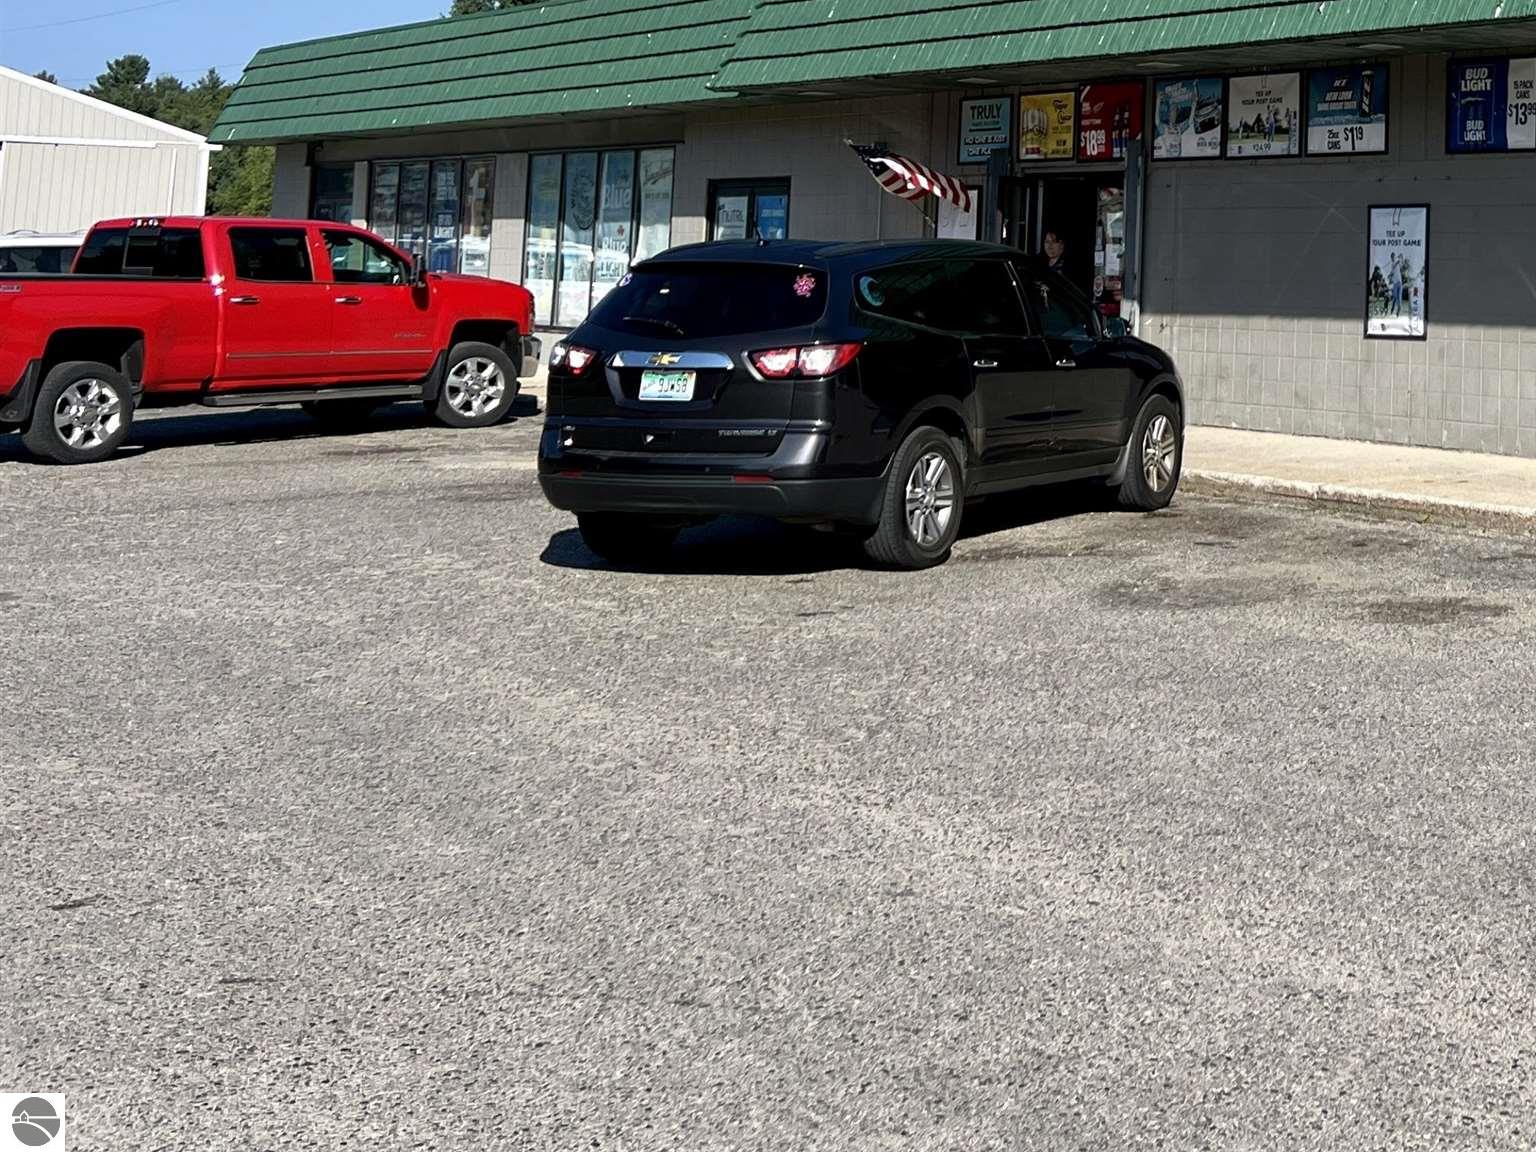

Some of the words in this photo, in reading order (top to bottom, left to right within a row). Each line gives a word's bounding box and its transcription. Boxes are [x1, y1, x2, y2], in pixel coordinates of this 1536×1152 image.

[1465, 67, 1488, 80] BUD
[1460, 79, 1492, 92] LIGHT
[1520, 80, 1533, 89] PACK
[1516, 91, 1530, 99] CANS
[970, 103, 1002, 121] TRULY
[1466, 120, 1484, 131] BUD
[1463, 130, 1486, 142] LIGHT
[604, 184, 631, 208] Blue
[1385, 230, 1396, 238] TEE
[1397, 230, 1406, 238] UP
[602, 236, 627, 252] Blue
[1387, 239, 1402, 247] POST
[1403, 239, 1421, 247] GAME
